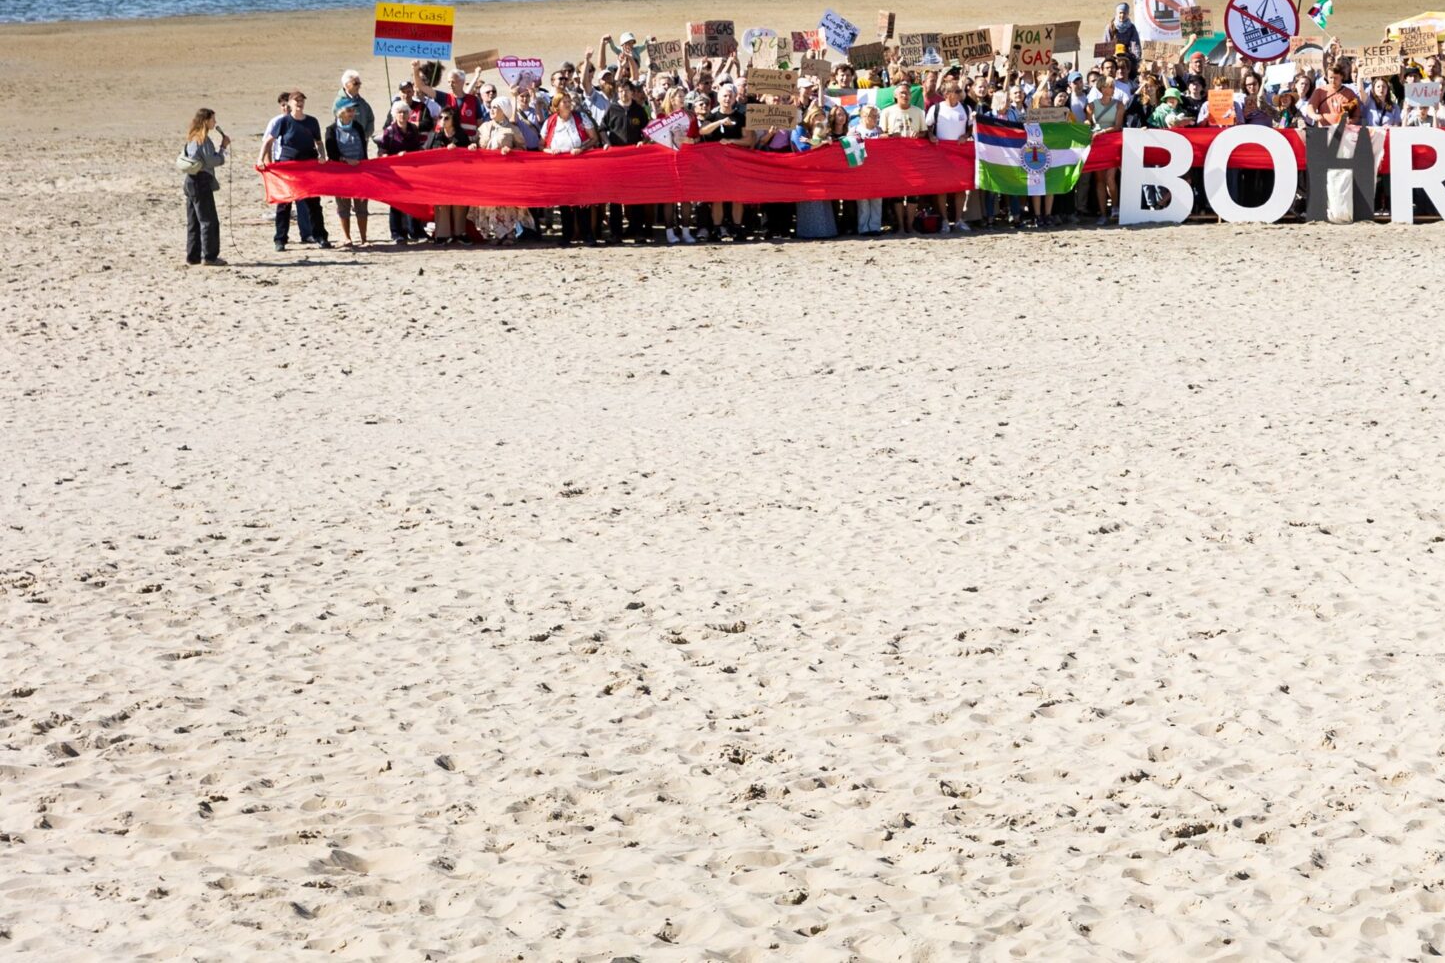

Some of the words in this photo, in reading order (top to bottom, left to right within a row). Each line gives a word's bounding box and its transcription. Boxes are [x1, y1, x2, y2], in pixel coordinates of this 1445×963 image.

[383, 5, 415, 19] Mehr
[716, 22, 733, 36] GAS
[1015, 29, 1040, 44] KOA
[942, 35, 963, 48] KEEP
[966, 33, 974, 45] IT
[978, 30, 987, 42] IN
[376, 41, 406, 53] Meer
[647, 42, 664, 57] EXIT
[665, 41, 681, 54] GAS
[943, 49, 959, 60] THE
[962, 44, 992, 58] GROUND
[1364, 45, 1393, 56] KEEP
[1022, 49, 1051, 66] GAS
[1365, 57, 1375, 66] IT
[642, 123, 662, 135] Team
[661, 111, 684, 126] Robbe
